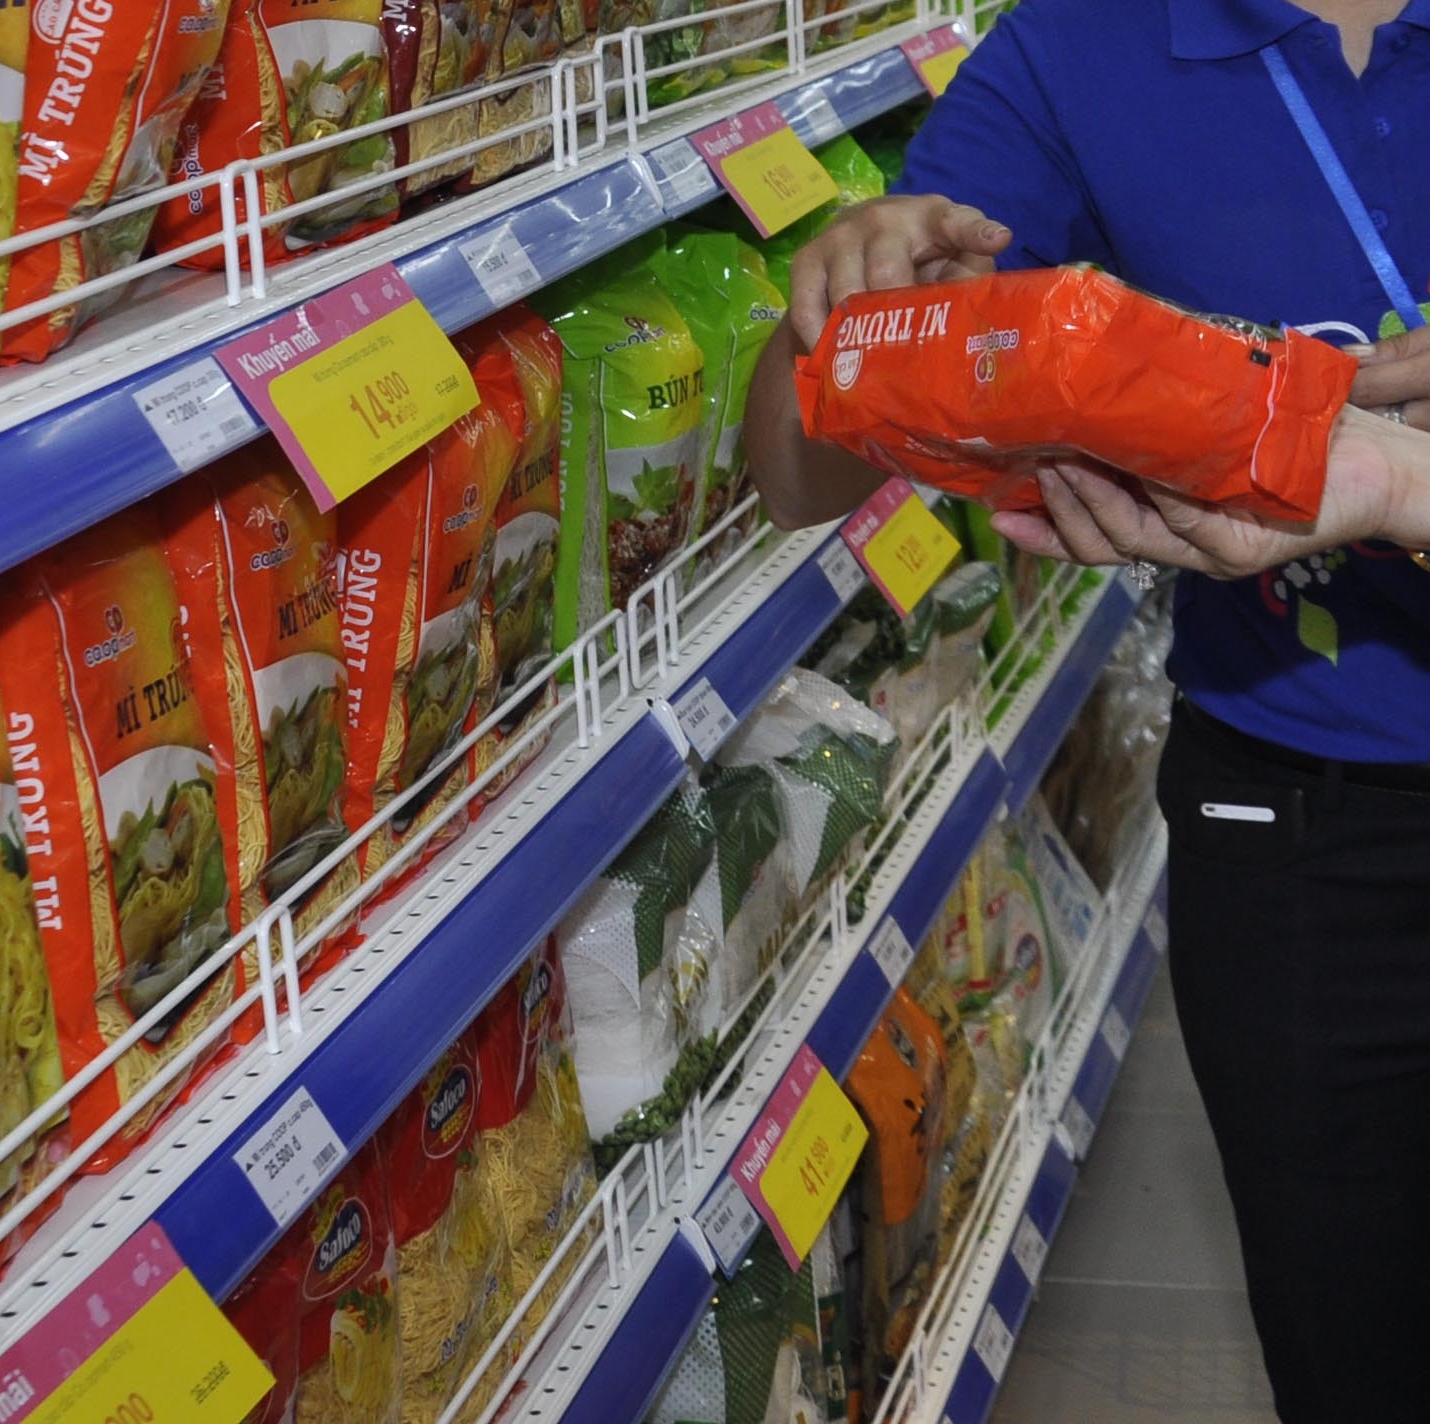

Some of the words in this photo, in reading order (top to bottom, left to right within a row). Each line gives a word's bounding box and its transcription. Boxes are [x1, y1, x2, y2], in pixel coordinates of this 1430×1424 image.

[836, 307, 915, 351] TRỨNG
[916, 300, 952, 345] MÌ
[236, 332, 300, 381] Khuyến
[349, 384, 396, 440] 14
[375, 370, 411, 405] 900
[116, 684, 142, 739] MÌ
[143, 664, 189, 722] TRỨ
[429, 1075, 467, 1132] Safoco
[318, 1208, 362, 1273] Safoco
